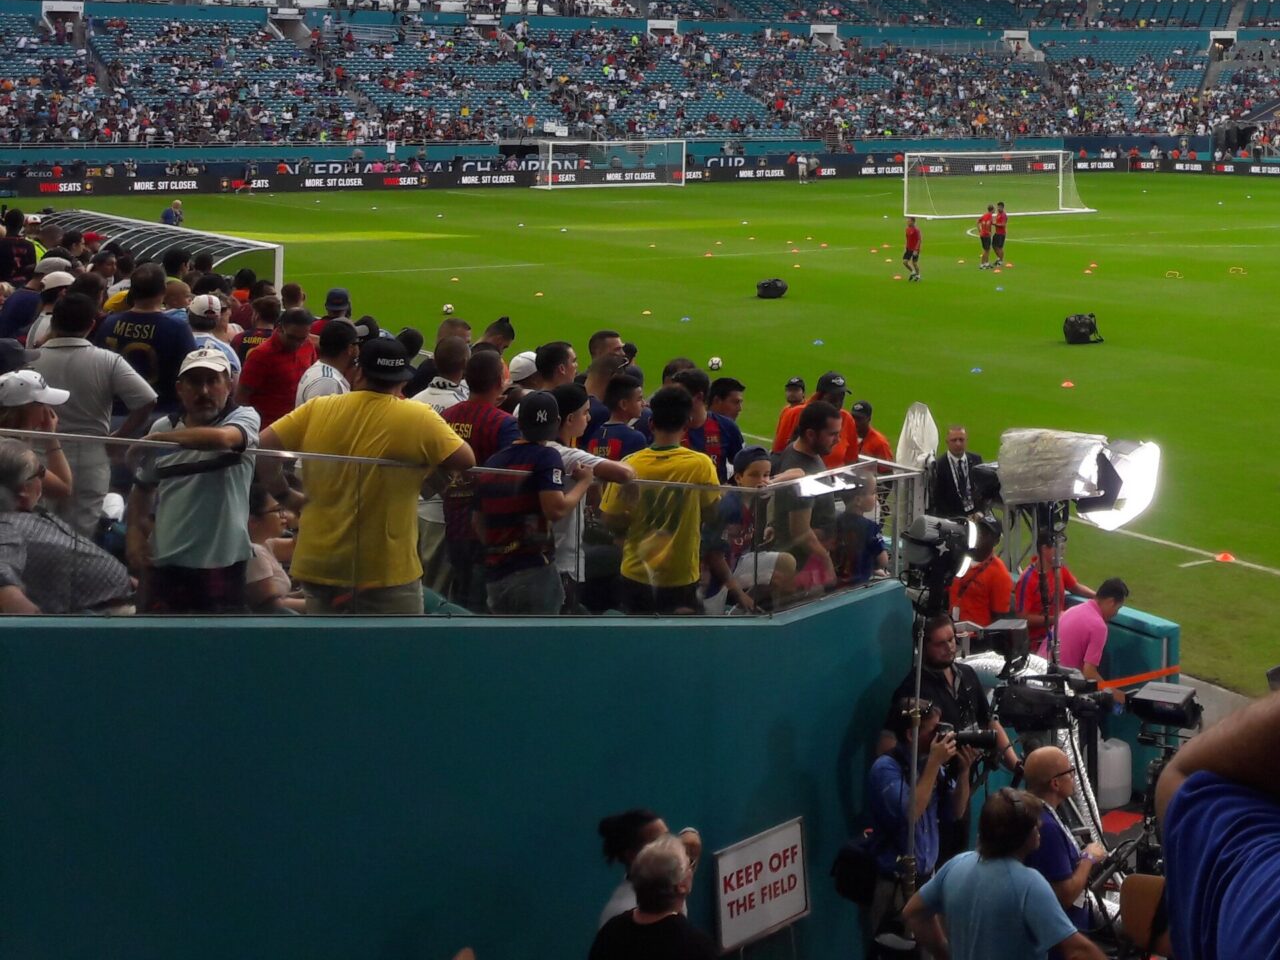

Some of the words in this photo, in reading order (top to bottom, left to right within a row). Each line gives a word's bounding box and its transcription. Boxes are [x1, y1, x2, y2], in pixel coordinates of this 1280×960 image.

[158, 181, 169, 189] SIT
[327, 178, 338, 186] SIT
[113, 320, 155, 339] MESSI
[377, 358, 396, 367] NIKE
[724, 861, 764, 895] KEEP
[769, 844, 799, 873] OFF
[727, 892, 756, 919] THE
[760, 874, 797, 905] FIELD
